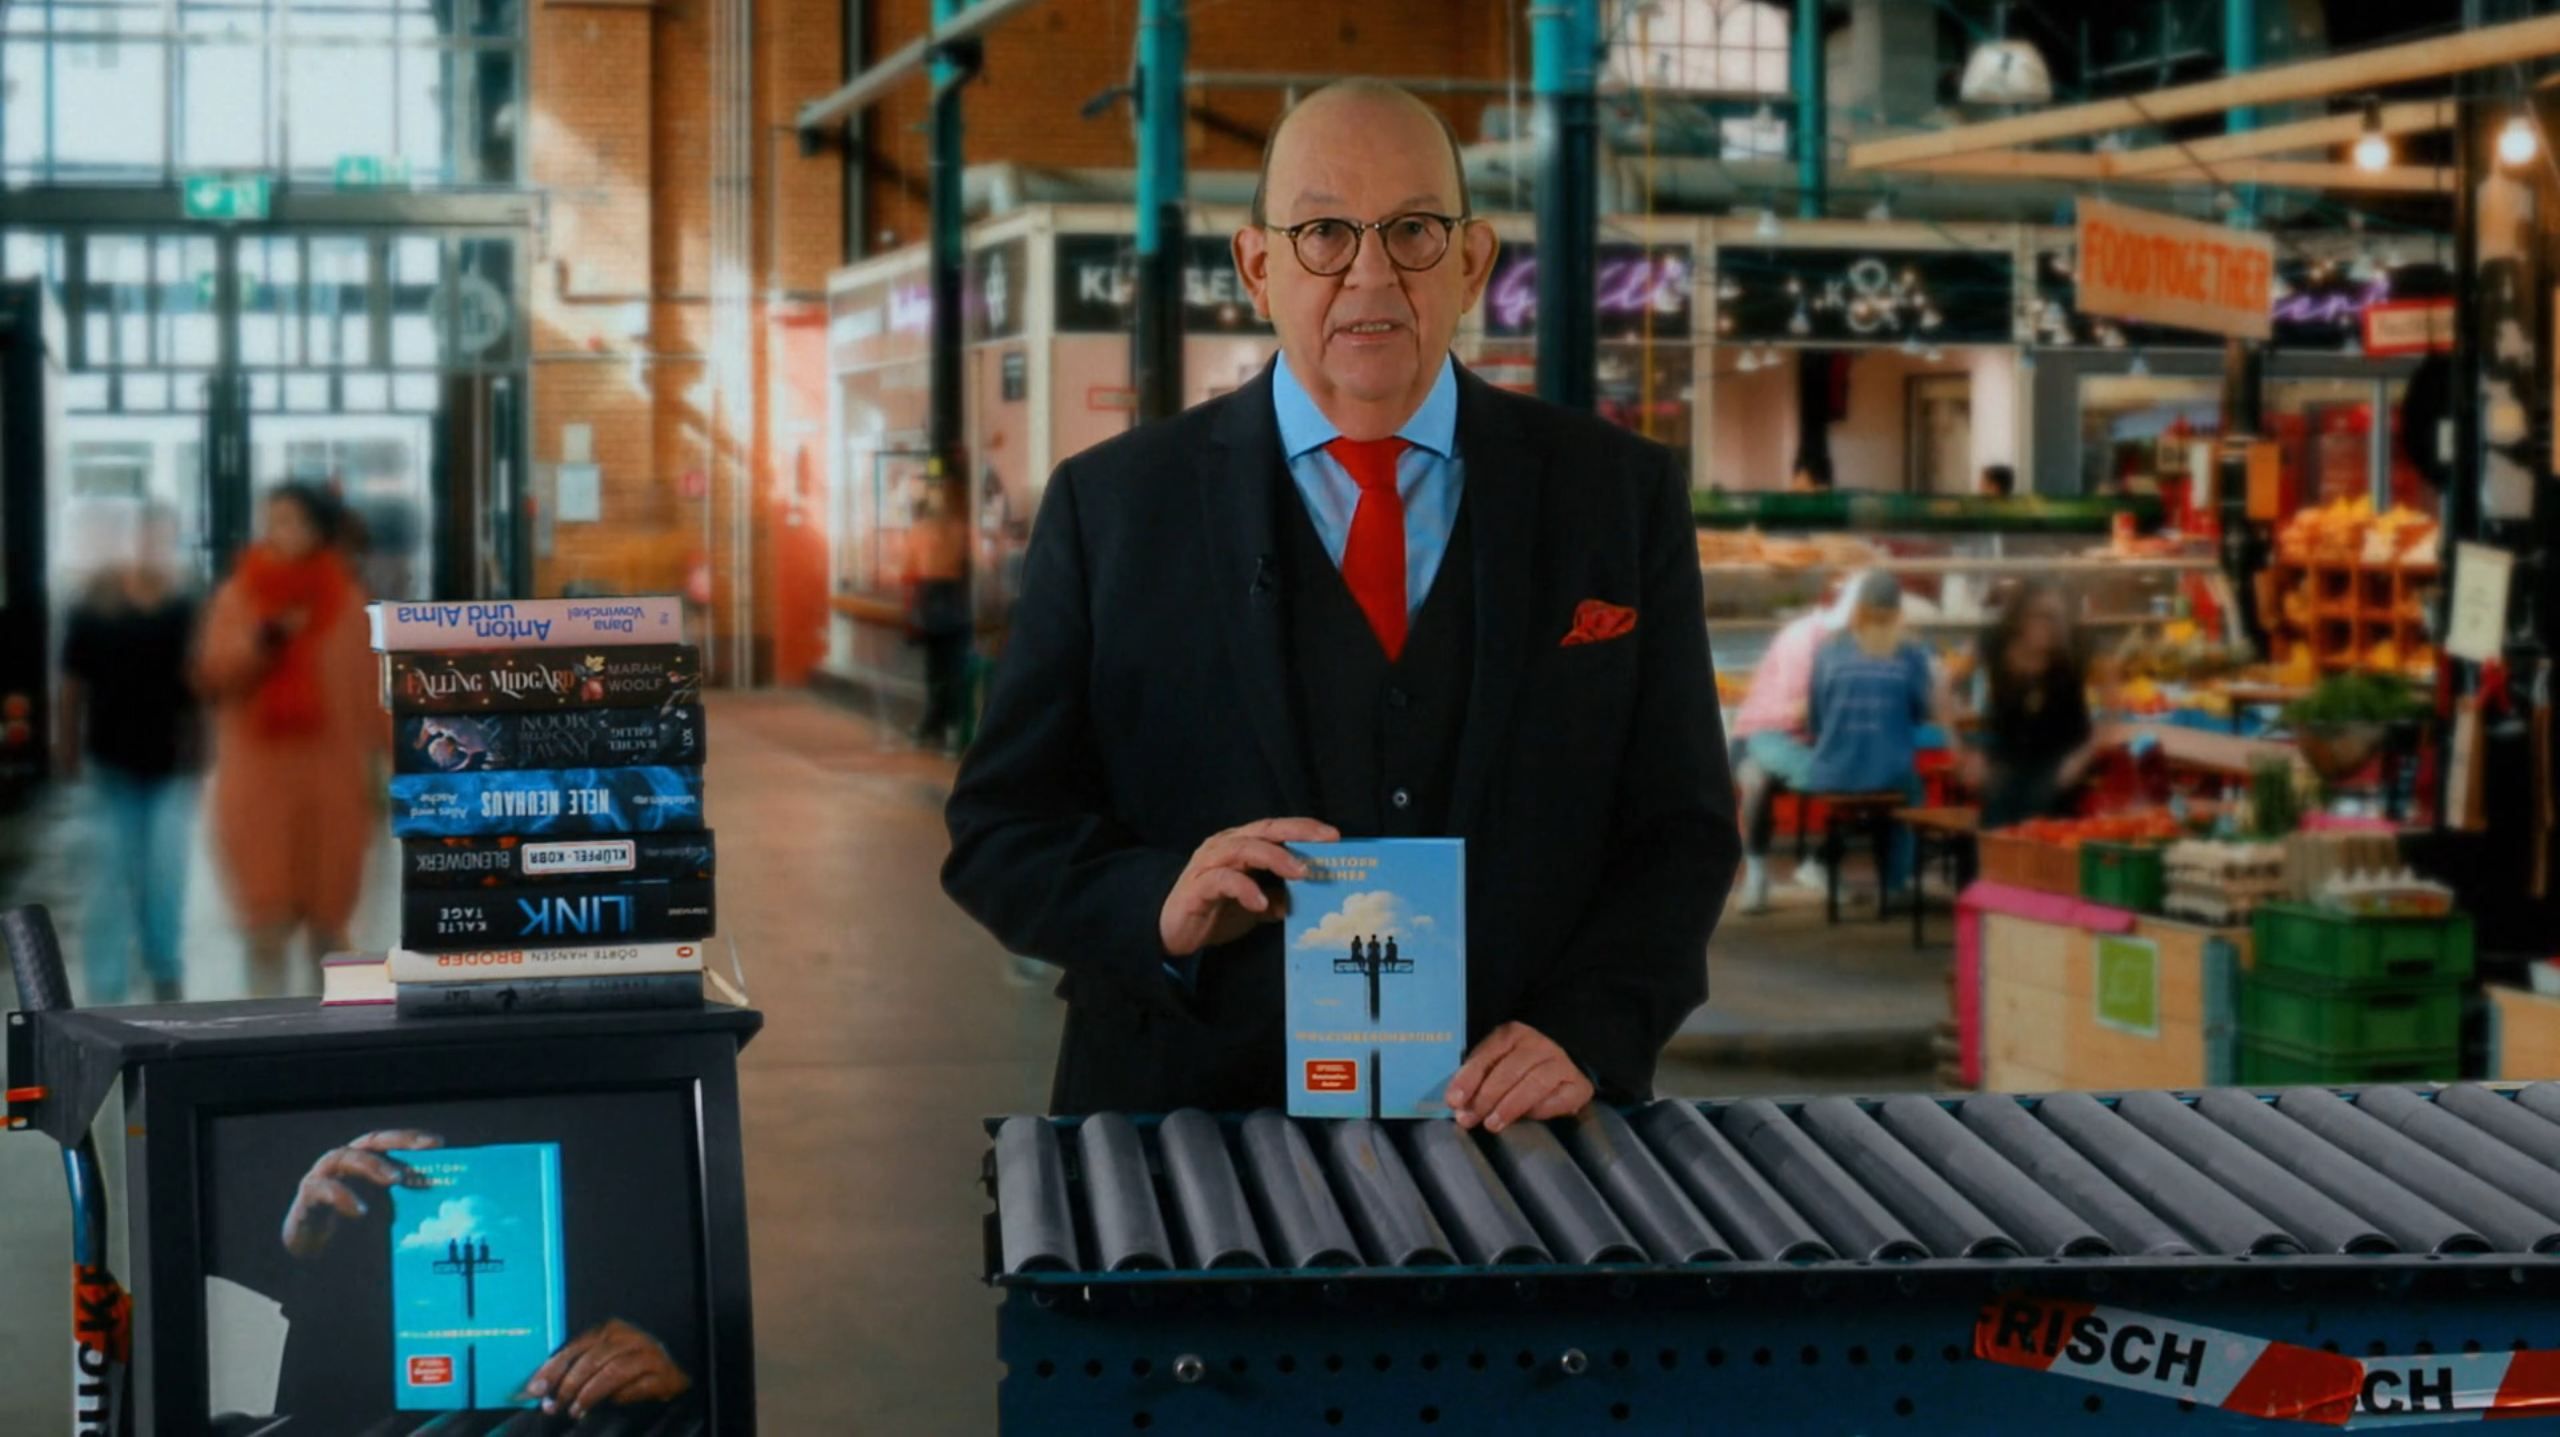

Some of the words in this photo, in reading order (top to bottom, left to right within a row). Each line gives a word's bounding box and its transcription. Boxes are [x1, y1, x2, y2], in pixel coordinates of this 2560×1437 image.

[397, 605, 461, 627] Alma
[467, 604, 515, 626] und
[567, 606, 645, 621] Vowinckel
[476, 619, 552, 641] Anton
[594, 618, 634, 633] Dana
[607, 662, 664, 675] MARAH
[406, 667, 482, 698] FALLING
[490, 663, 576, 698] MIDGARD
[607, 677, 664, 691] WOOLF
[520, 713, 590, 731] MOON
[610, 726, 654, 739] GILLIG
[608, 739, 658, 751] RACHEL
[419, 792, 460, 805] Asche
[481, 789, 561, 818] NEUHAUS
[568, 788, 610, 815] NELE
[410, 806, 437, 820] wird
[440, 805, 470, 820] Alles
[416, 850, 512, 872] BLENDWERK
[530, 851, 566, 865] KOBR
[574, 848, 628, 866] KLÜPFEL
[441, 906, 484, 921] TAGE
[517, 895, 635, 937] LINK
[437, 920, 488, 934] KALTE
[437, 949, 525, 967] BRODER
[531, 950, 588, 963] HANSEN
[593, 947, 639, 961] DÖRTE
[2355, 1366, 2455, 1414] CH
